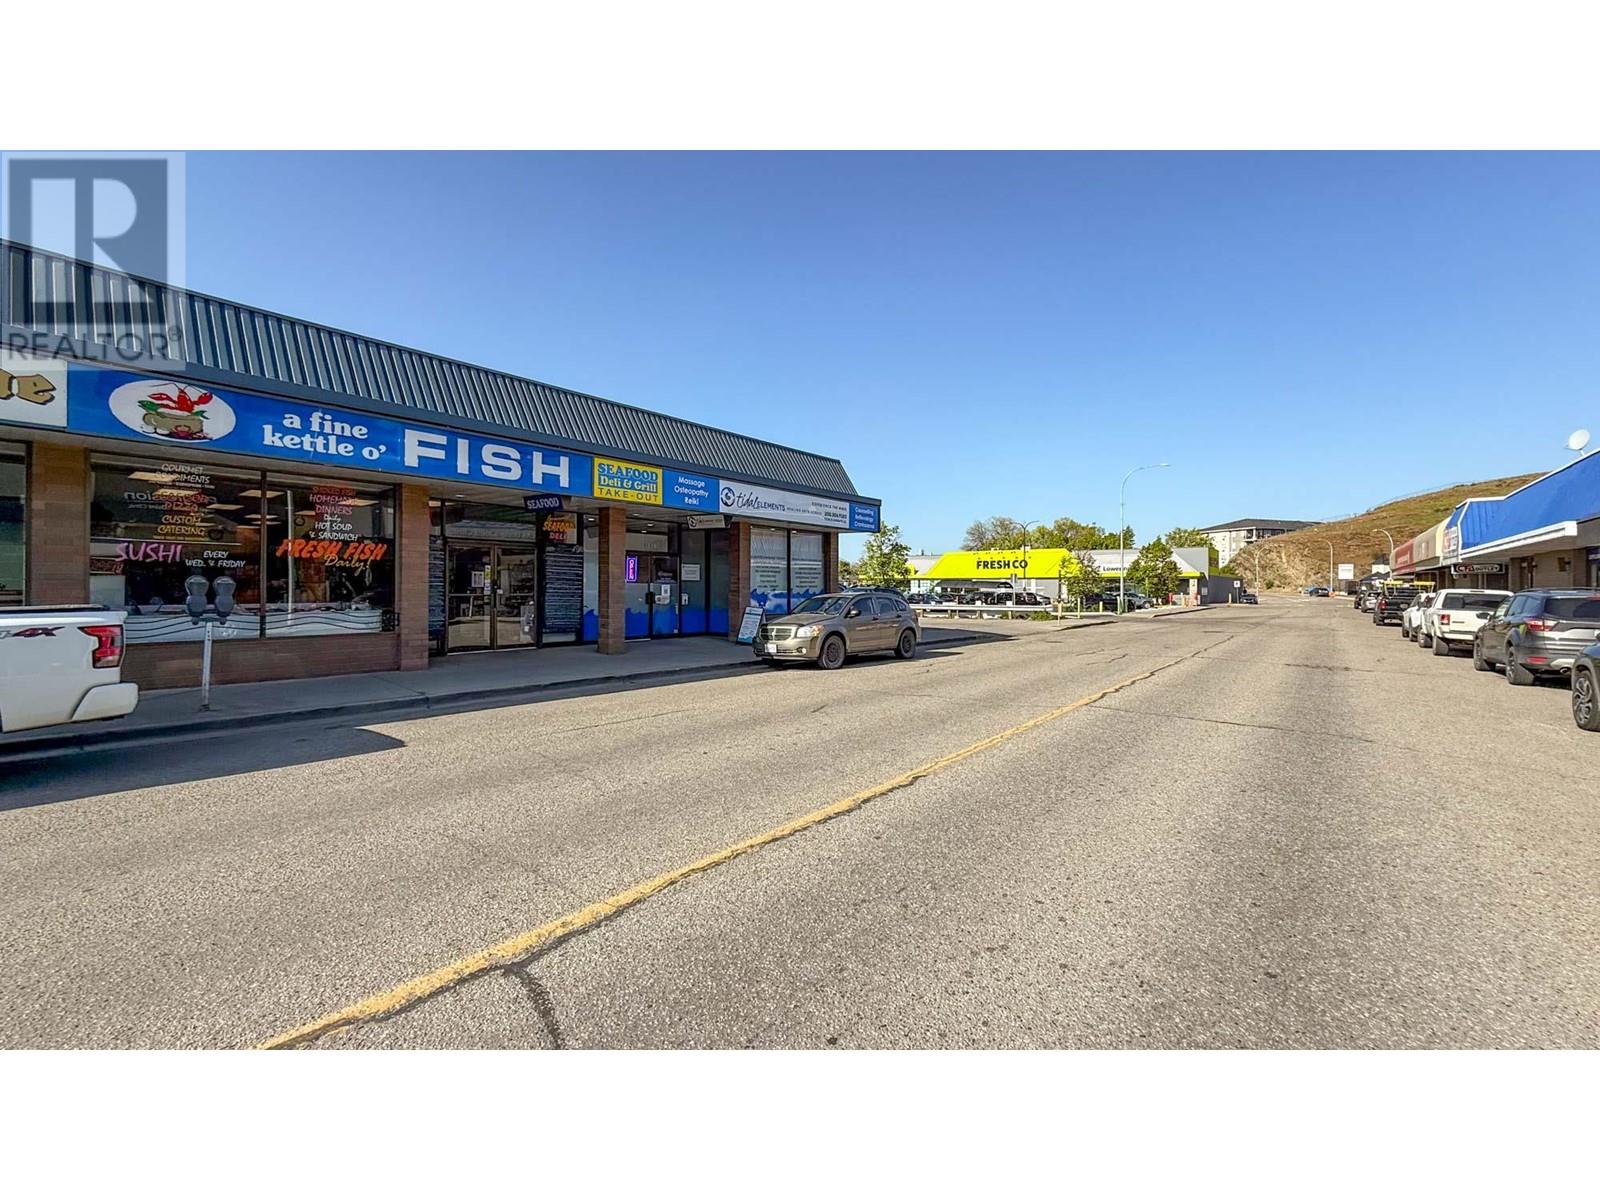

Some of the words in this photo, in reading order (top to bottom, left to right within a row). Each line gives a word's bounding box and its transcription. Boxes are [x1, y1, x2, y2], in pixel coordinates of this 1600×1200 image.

[282, 413, 302, 430] a
[310, 411, 369, 440] fine
[262, 424, 354, 457] kettle
[404, 429, 570, 488] FISH
[161, 463, 204, 475] GOURMET
[598, 463, 658, 481] SEAFOOD
[600, 475, 621, 488] Deli
[623, 478, 632, 488] &
[634, 481, 657, 492] Grill
[678, 476, 706, 488] Massage
[598, 487, 659, 502] TAKE-OUT
[674, 485, 709, 499] Osteopathy
[526, 497, 559, 510] SEAFOOD
[684, 496, 699, 505] Reiki
[315, 503, 353, 515] DINNERS
[161, 514, 202, 526] CUSTOM
[315, 521, 330, 530] HOT
[332, 522, 353, 531] SOUP
[157, 525, 206, 537] CATERING
[318, 531, 358, 541] SANDWICH
[115, 542, 183, 563] SUSHI
[203, 551, 229, 559] EVERY
[275, 538, 343, 559] FRESH
[343, 542, 388, 561] FISH
[218, 559, 247, 568] FRIDAY
